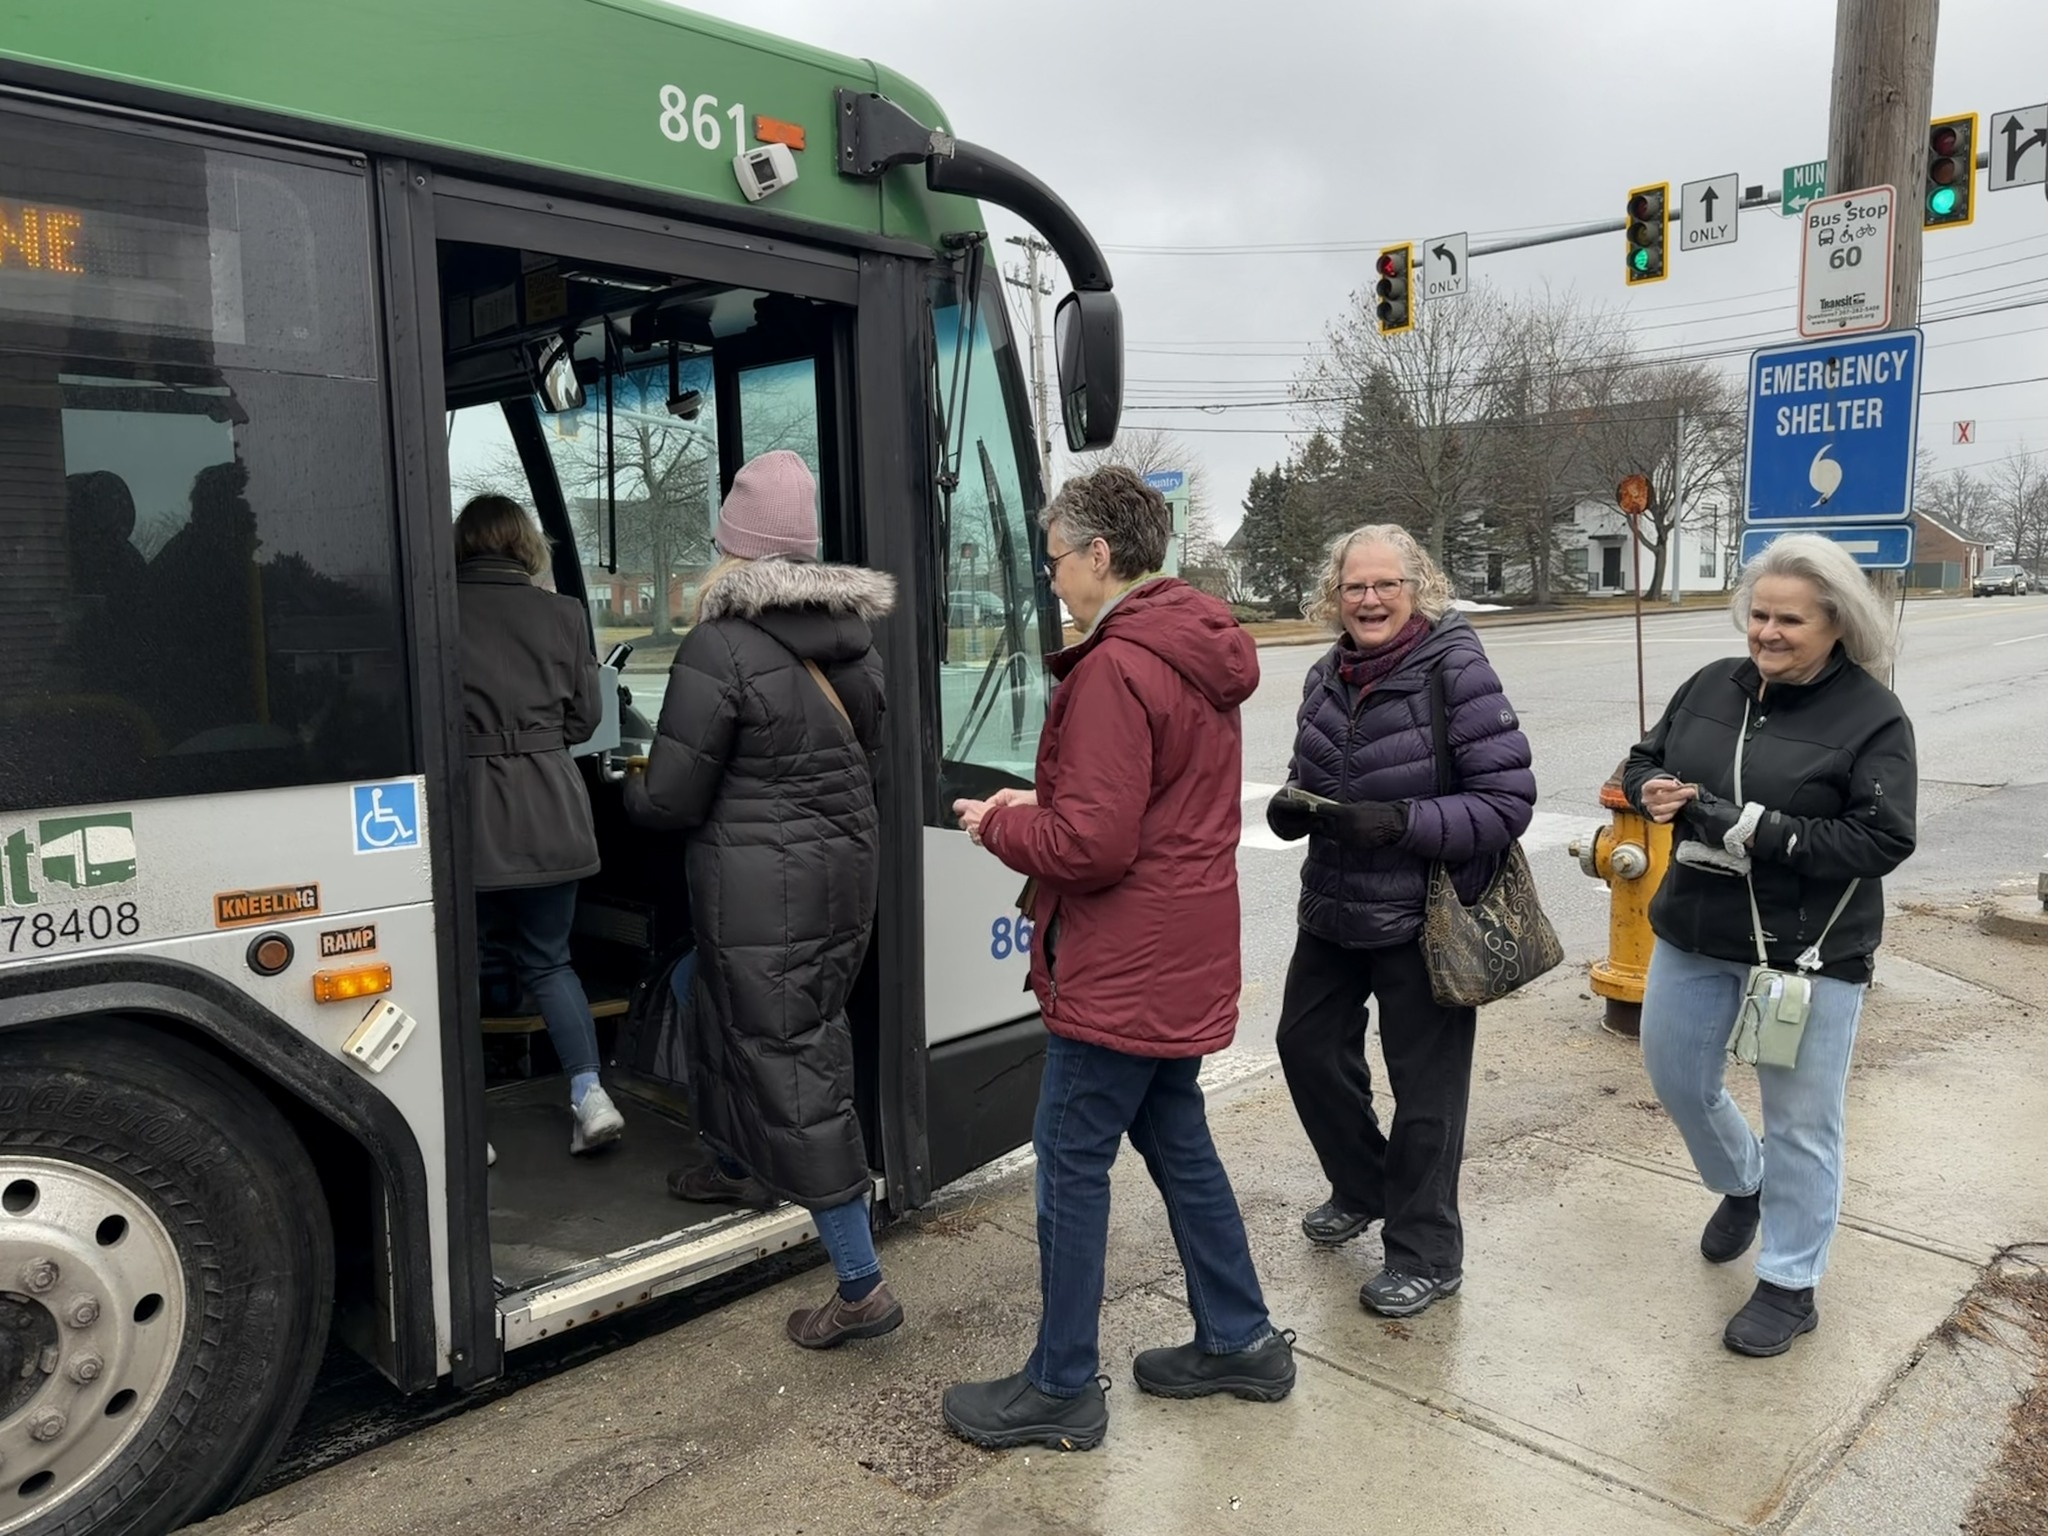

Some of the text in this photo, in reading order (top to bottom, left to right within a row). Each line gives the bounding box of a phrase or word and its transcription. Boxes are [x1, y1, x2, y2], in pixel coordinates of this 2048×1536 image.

[659, 84, 746, 155] 861
[1794, 162, 1825, 188] MUN
[1810, 204, 1888, 229] Bus Stop
[1689, 224, 1728, 243] ONLY
[1830, 246, 1862, 269] 60
[1430, 278, 1461, 295] ONLY
[1759, 349, 1909, 396] EMERGENCY
[1776, 397, 1883, 436] SHELTER
[222, 889, 315, 919] KNEELING
[1, 902, 140, 952] 78408
[323, 930, 374, 953] RAMP
